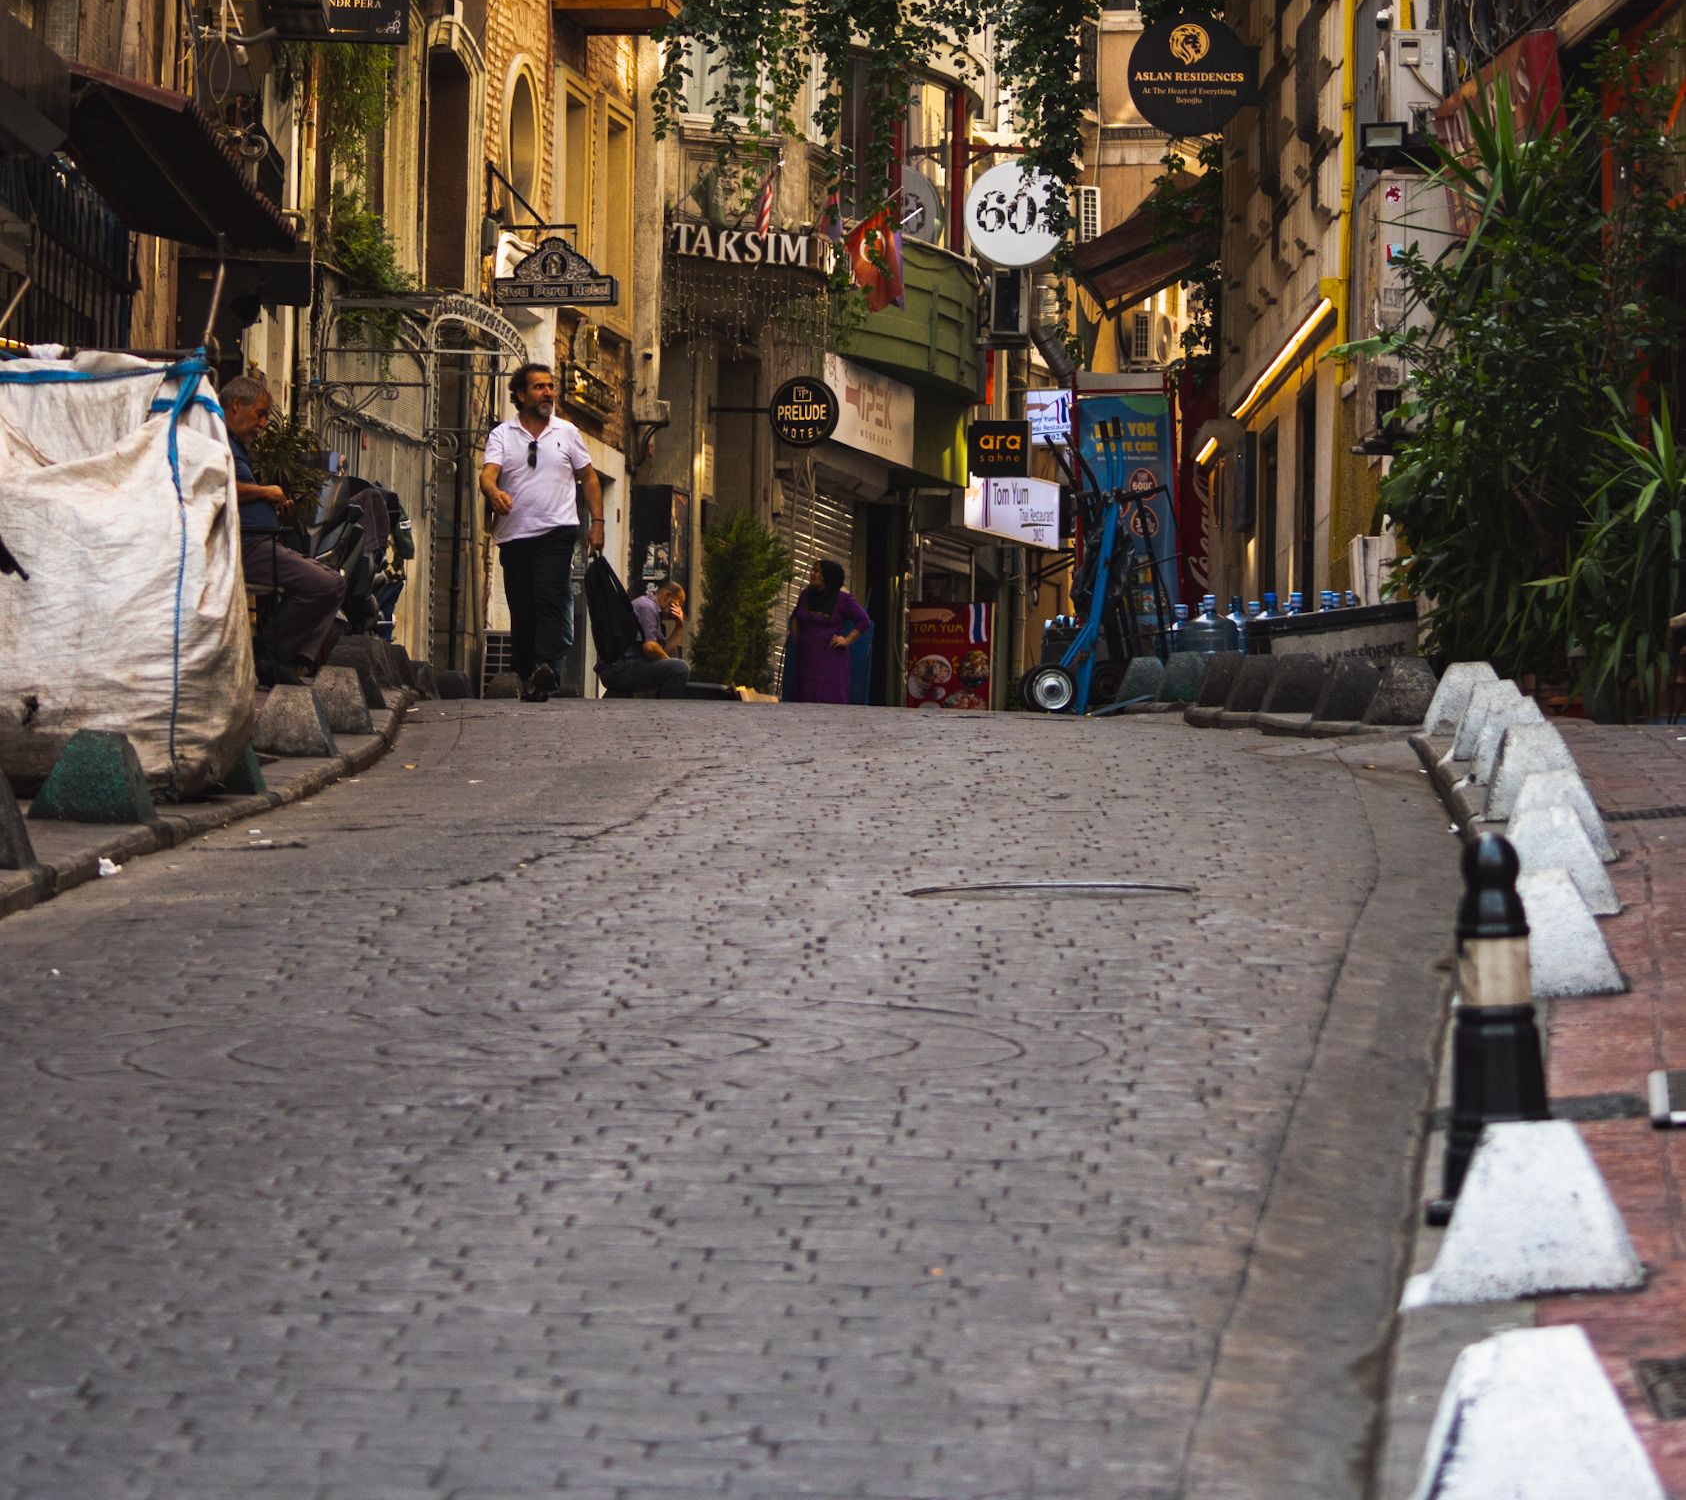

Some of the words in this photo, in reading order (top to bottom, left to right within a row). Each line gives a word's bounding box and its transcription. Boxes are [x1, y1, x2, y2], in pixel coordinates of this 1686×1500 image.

[1135, 71, 1172, 82] ASLAN
[1175, 71, 1245, 82] RESIDENCES
[1142, 86, 1151, 95] At
[1153, 86, 1166, 95] The
[1168, 87, 1188, 95] Heart
[1190, 87, 1198, 95] of
[1199, 87, 1237, 96] Everything
[673, 222, 808, 267] TAKSİM
[533, 284, 568, 297] Pera
[572, 282, 611, 296] Hotel
[777, 403, 827, 421] PRELUDE
[783, 424, 822, 439] HOTEL
[979, 434, 1021, 450] ara
[979, 453, 1021, 463] sahne
[993, 482, 1009, 505] Tom
[1012, 482, 1029, 505] Yum
[1019, 508, 1029, 522] Thai
[1030, 509, 1054, 522] Restaurant
[1033, 528, 1044, 542] 2023
[914, 623, 936, 633] TOM
[941, 622, 964, 633] YUM
